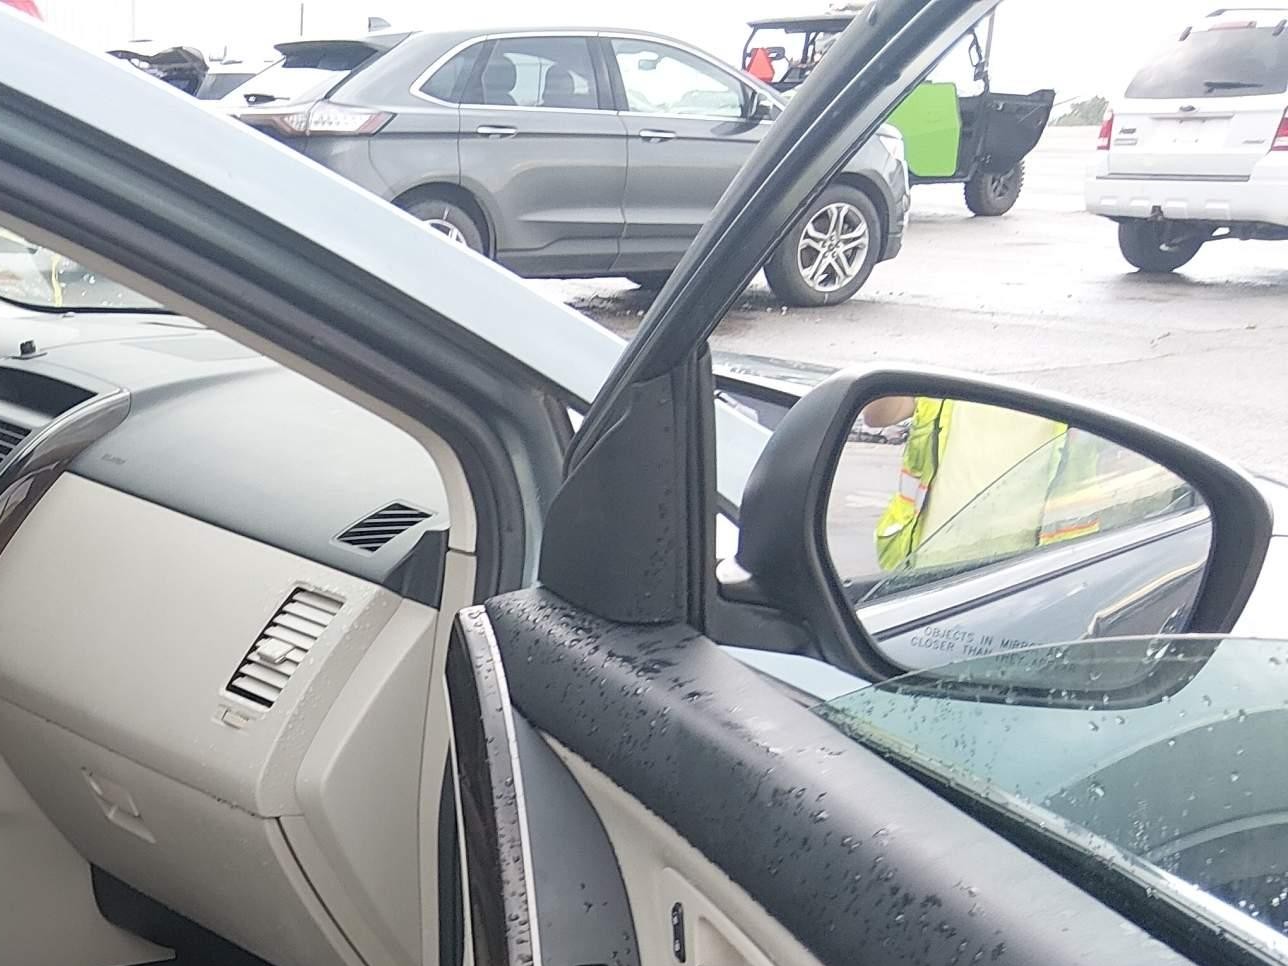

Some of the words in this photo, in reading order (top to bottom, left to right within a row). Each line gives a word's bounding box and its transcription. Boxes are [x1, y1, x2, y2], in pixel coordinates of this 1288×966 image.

[910, 635, 956, 652] CLOSER
[962, 645, 994, 658] THAN
[923, 625, 976, 643] OBJECTS
[980, 634, 994, 646] IN
